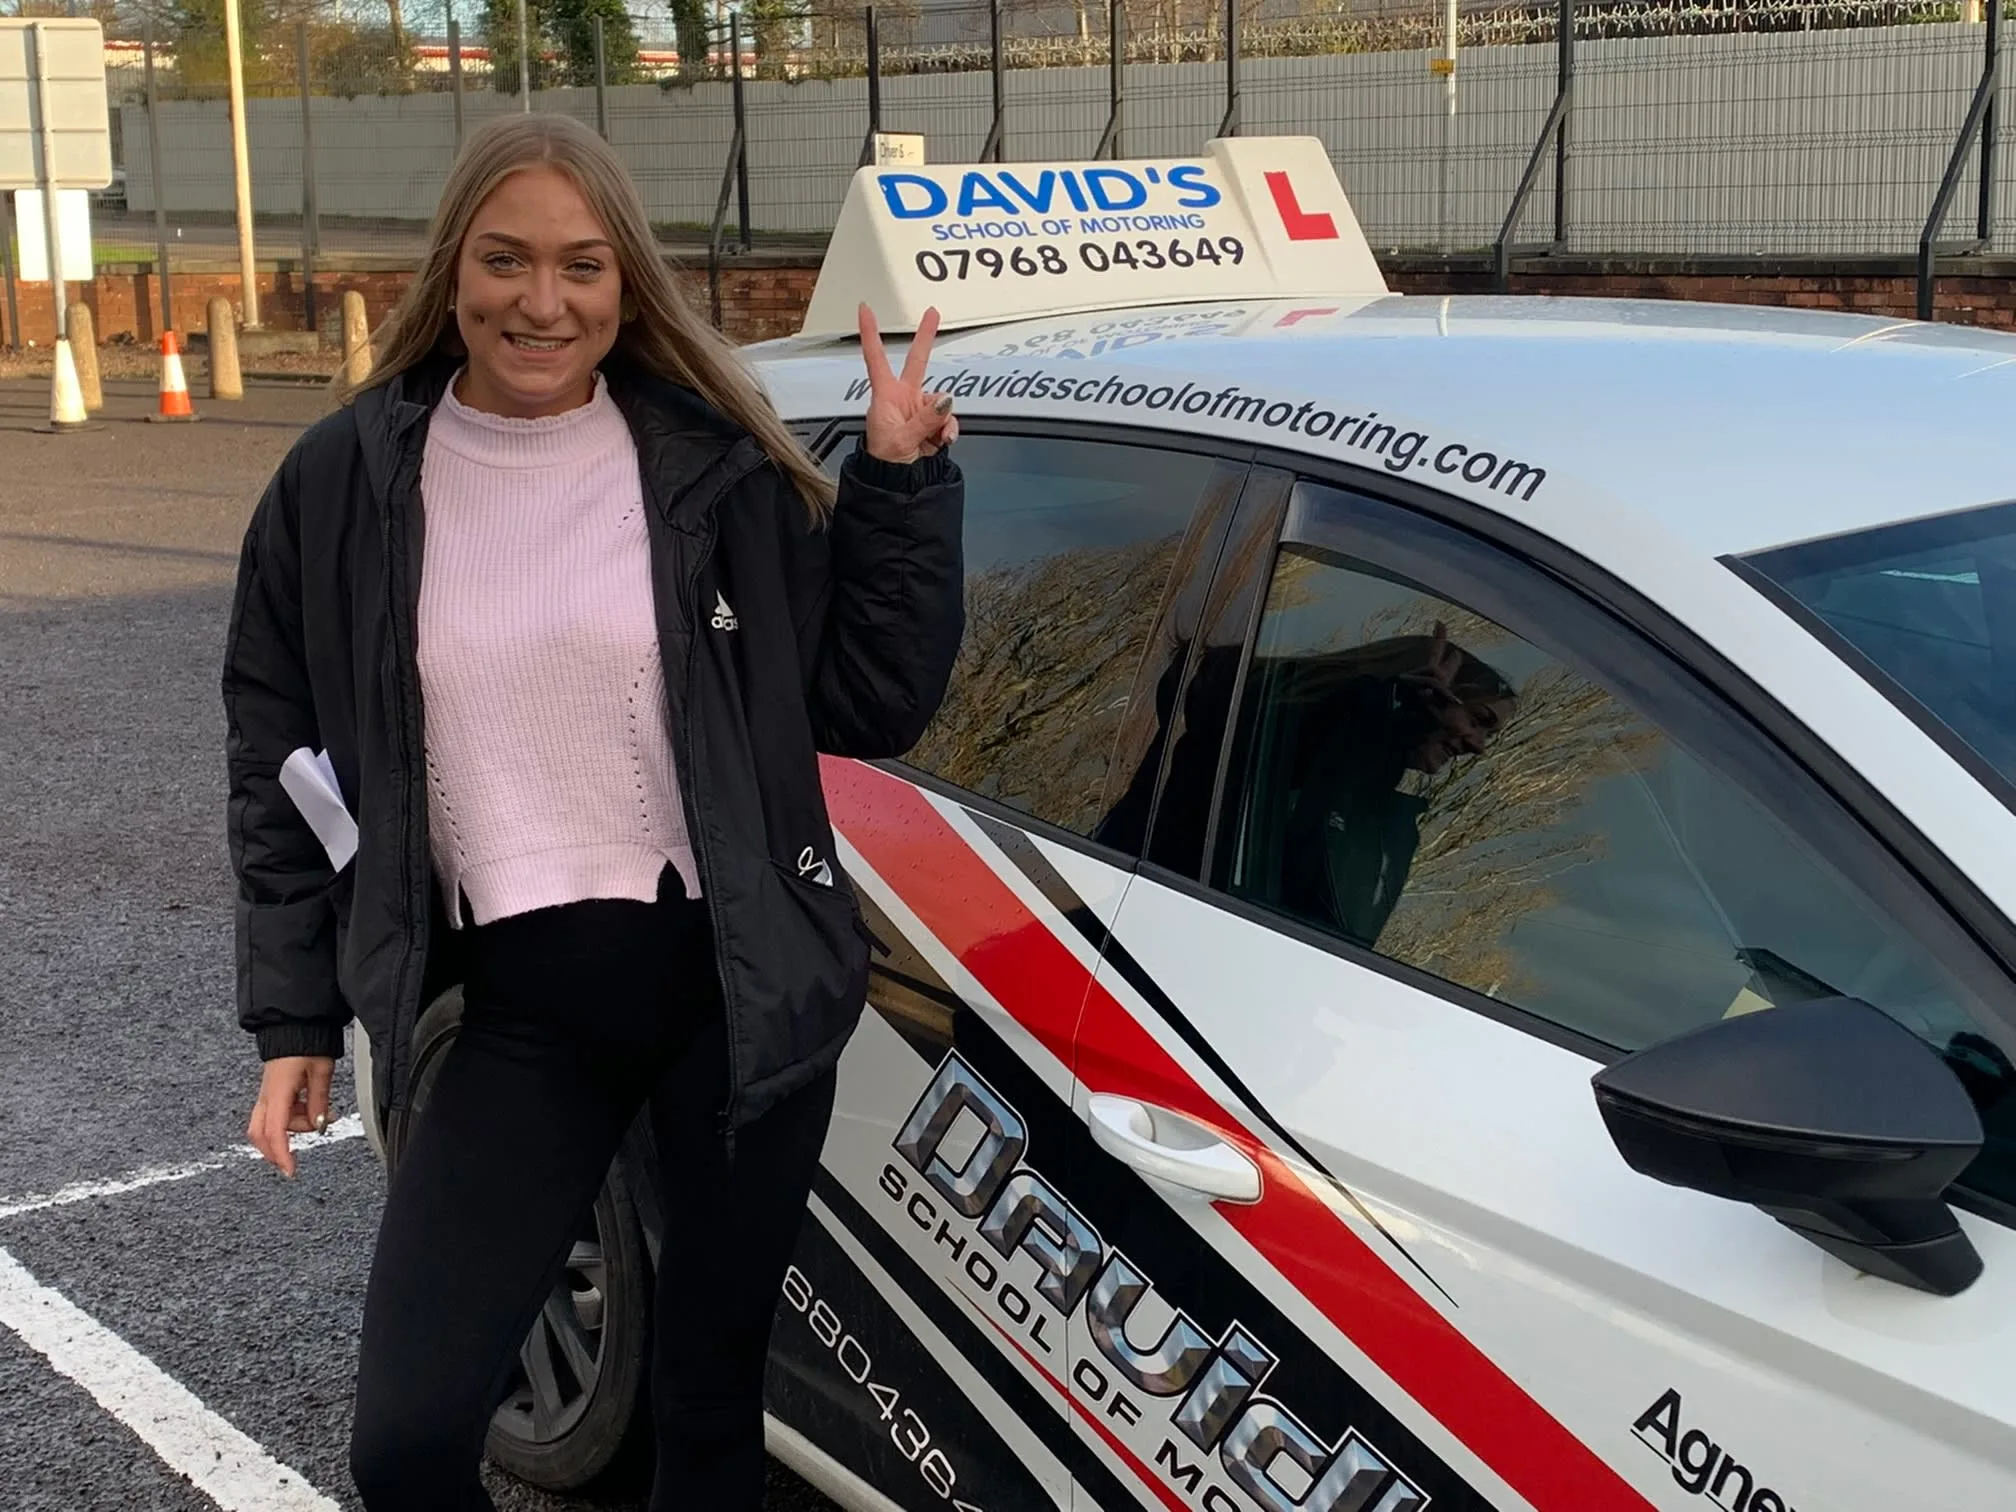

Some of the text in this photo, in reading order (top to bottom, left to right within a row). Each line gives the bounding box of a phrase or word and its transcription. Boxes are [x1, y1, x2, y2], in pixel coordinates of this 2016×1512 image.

[877, 166, 1222, 220] DAVID'S
[931, 213, 1206, 242] SCHOOL OF MOTORING
[1263, 170, 1339, 241] L
[914, 236, 1245, 283] 07968 043649
[843, 368, 1547, 502] w.davidsschoolofmotoring.com
[878, 1162, 1054, 1355] SCHOOL
[1072, 1357, 1143, 1427] OF
[1632, 1387, 1798, 1512] Agne
